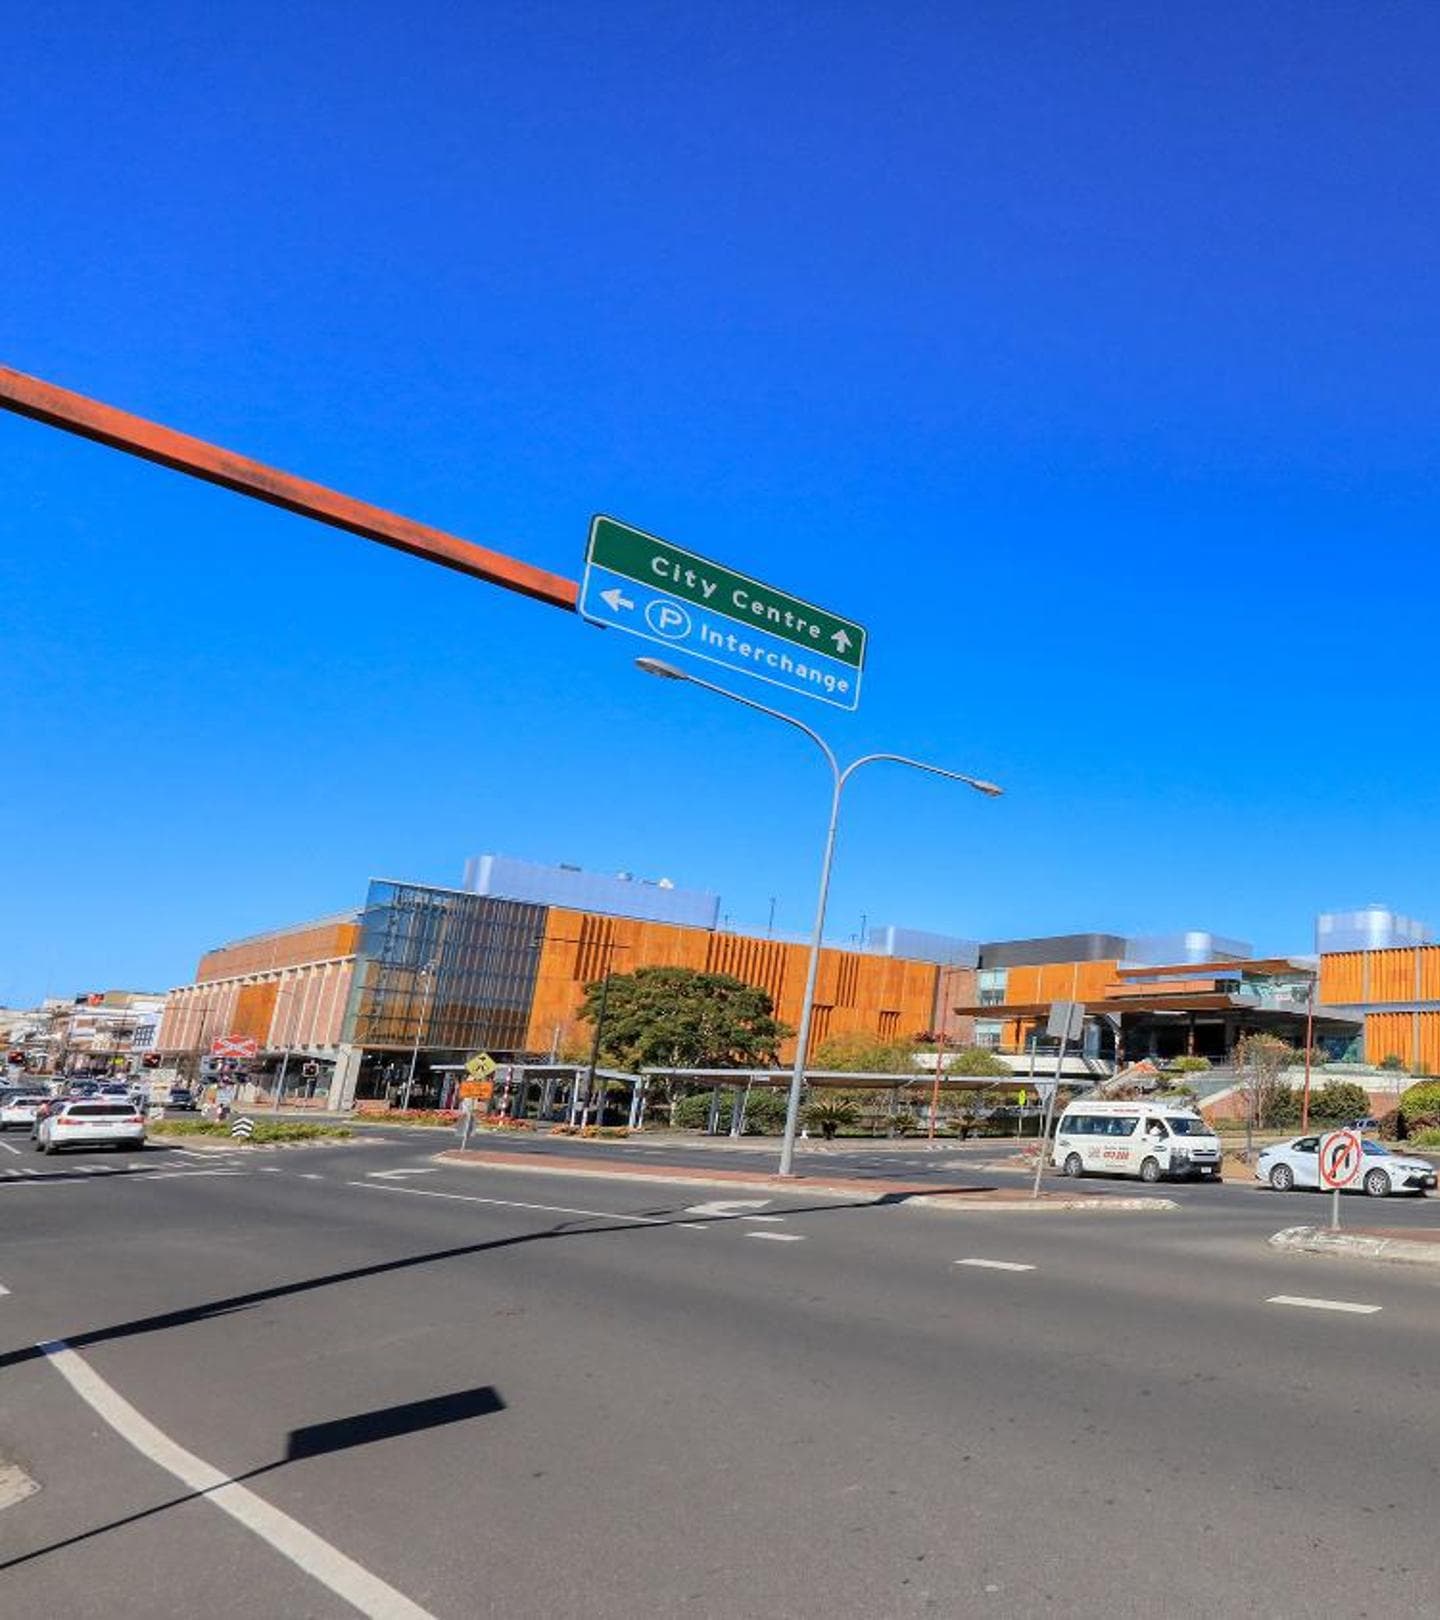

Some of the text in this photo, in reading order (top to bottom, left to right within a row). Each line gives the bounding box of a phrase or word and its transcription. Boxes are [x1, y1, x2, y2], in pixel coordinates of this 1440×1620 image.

[651, 556, 821, 639] City Centre
[659, 607, 849, 693] P Interchange
